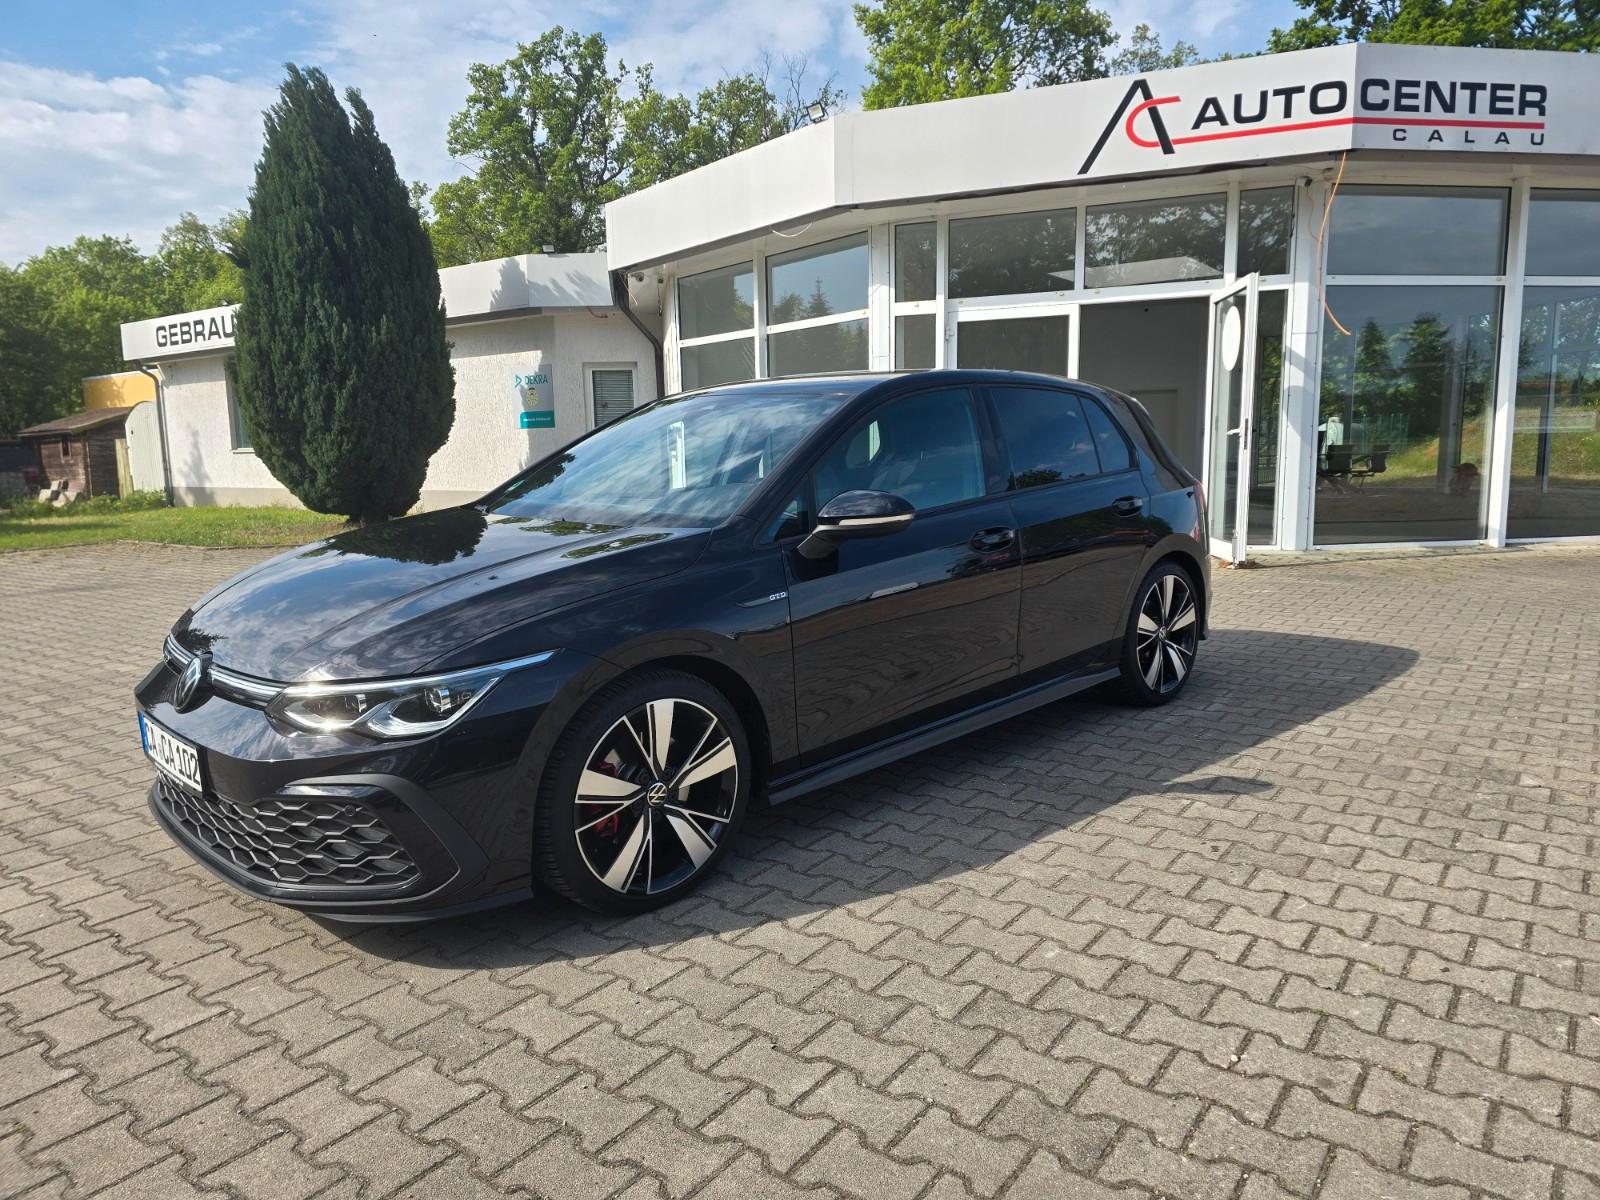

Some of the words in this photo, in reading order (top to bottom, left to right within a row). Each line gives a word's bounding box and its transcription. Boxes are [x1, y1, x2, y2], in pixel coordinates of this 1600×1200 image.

[1191, 80, 1348, 130] AUTO
[1360, 78, 1548, 116] CENTER
[1392, 128, 1545, 146] CALAU
[524, 374, 548, 384] DEKRA
[161, 734, 176, 770] CA
[176, 745, 201, 786] 102
